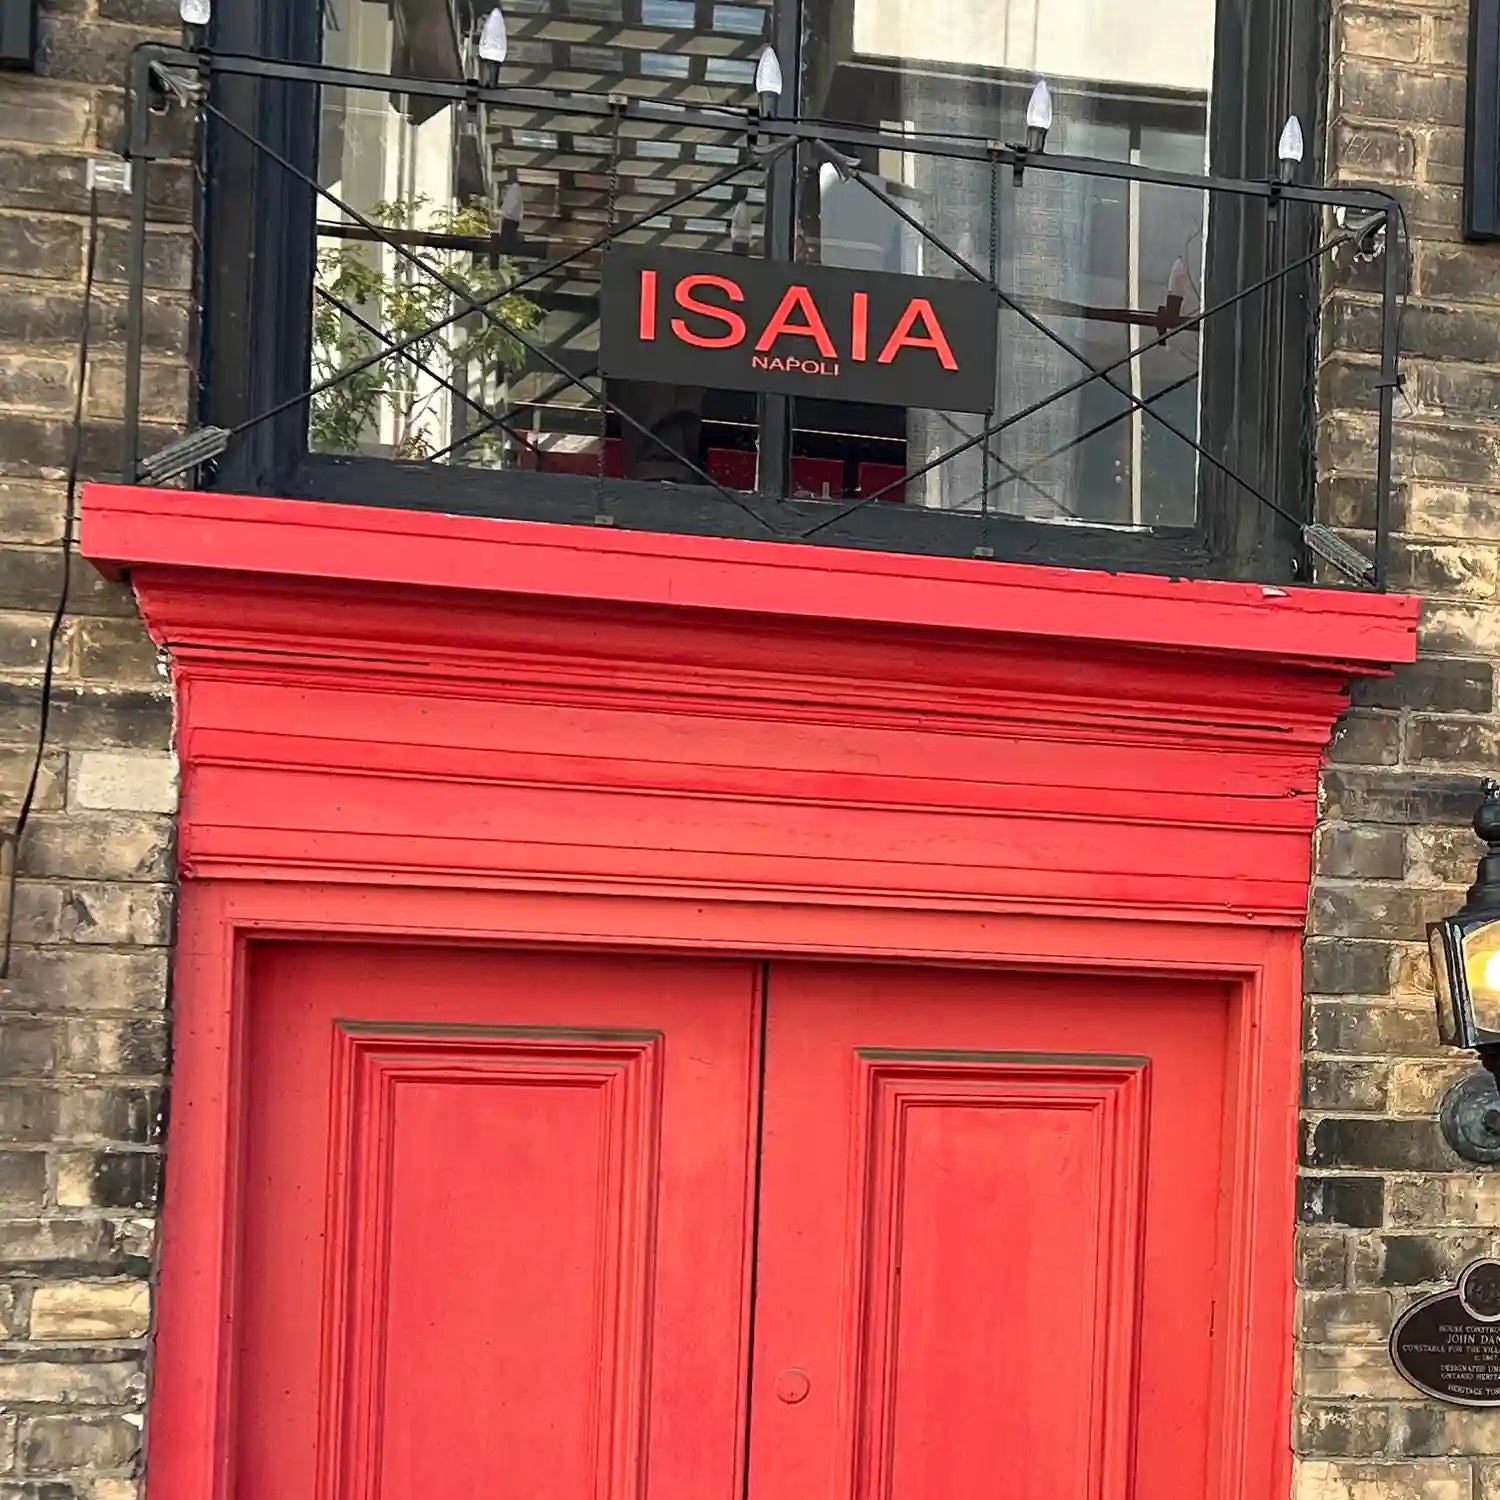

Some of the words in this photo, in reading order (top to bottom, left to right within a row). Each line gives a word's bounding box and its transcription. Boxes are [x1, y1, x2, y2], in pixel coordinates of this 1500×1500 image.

[639, 270, 959, 371] ISAIA
[752, 355, 840, 377] NAPOLI
[1447, 1334, 1475, 1344] JOHN
